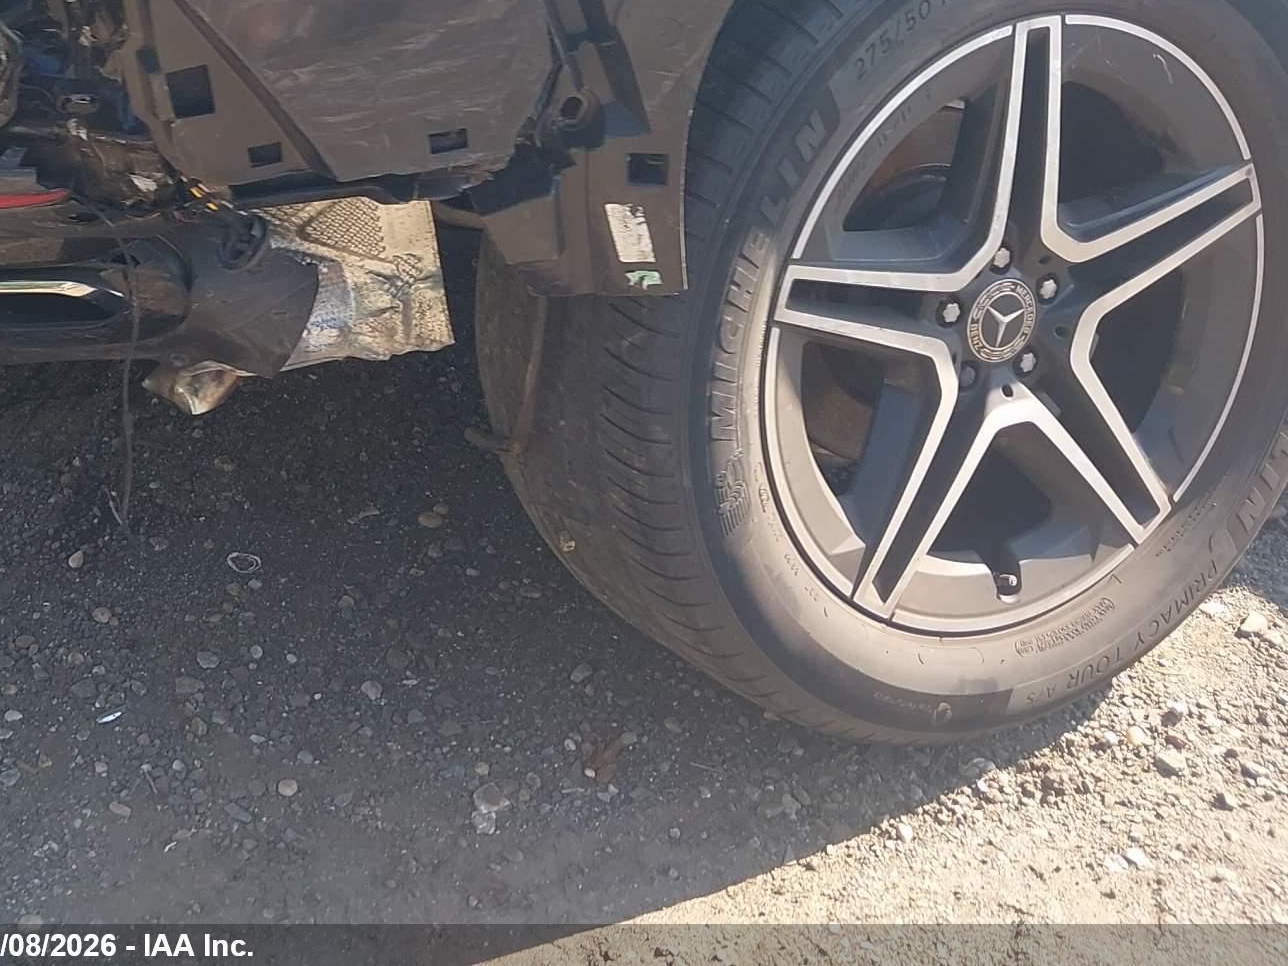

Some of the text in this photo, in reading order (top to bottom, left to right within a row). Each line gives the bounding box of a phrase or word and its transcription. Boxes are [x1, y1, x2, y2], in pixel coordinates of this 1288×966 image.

[711, 107, 829, 442] MICHELIN
[1133, 559, 1218, 651] PRIMACY
[1026, 684, 1057, 706] A/S
[1066, 646, 1121, 684] TOUR
